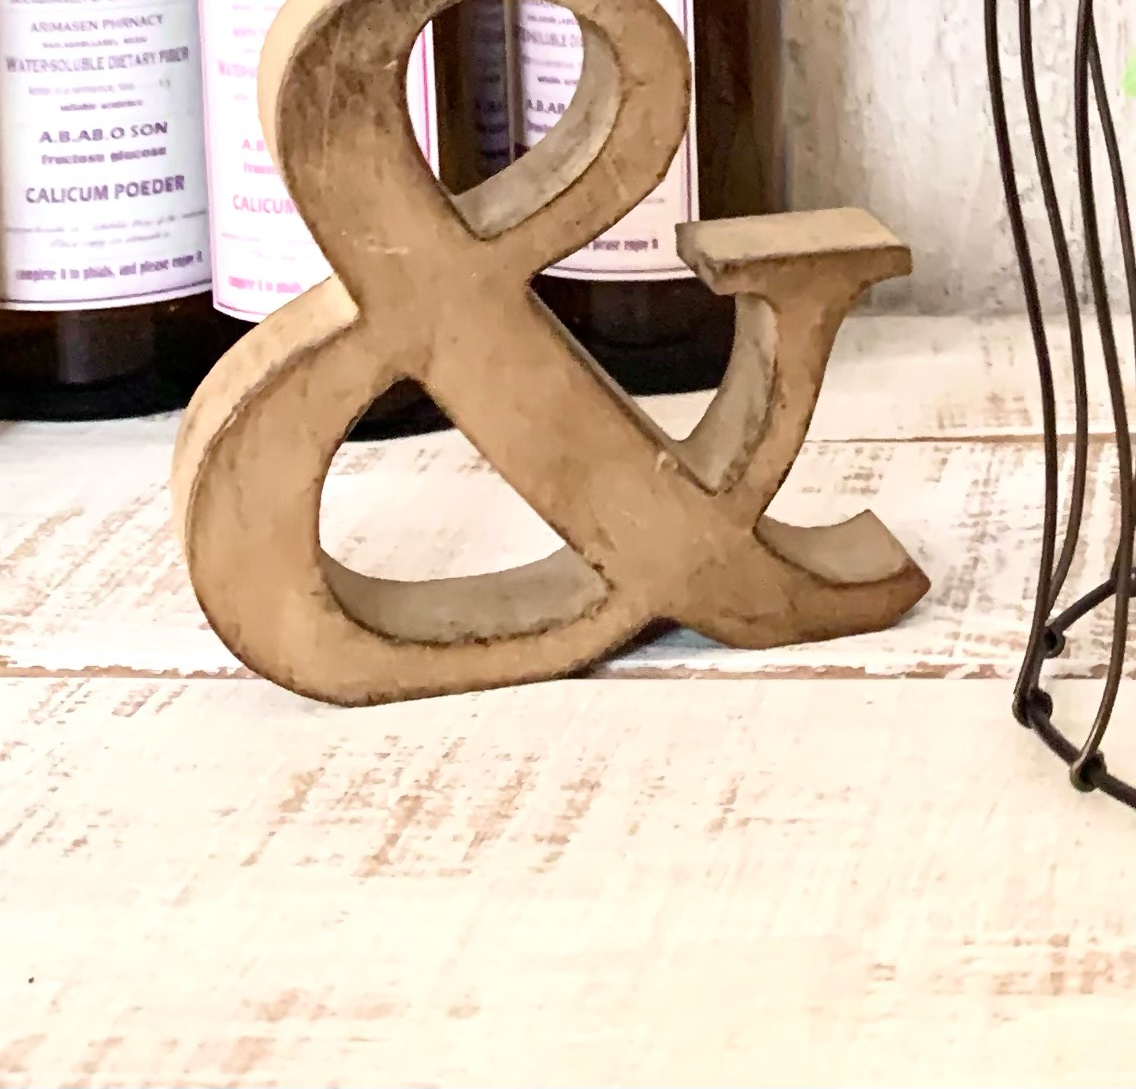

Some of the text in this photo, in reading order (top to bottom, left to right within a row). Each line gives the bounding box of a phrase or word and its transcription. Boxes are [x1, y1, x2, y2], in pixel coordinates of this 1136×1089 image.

[130, 121, 169, 138] SON
[25, 175, 185, 204] CALICUM POEDER
